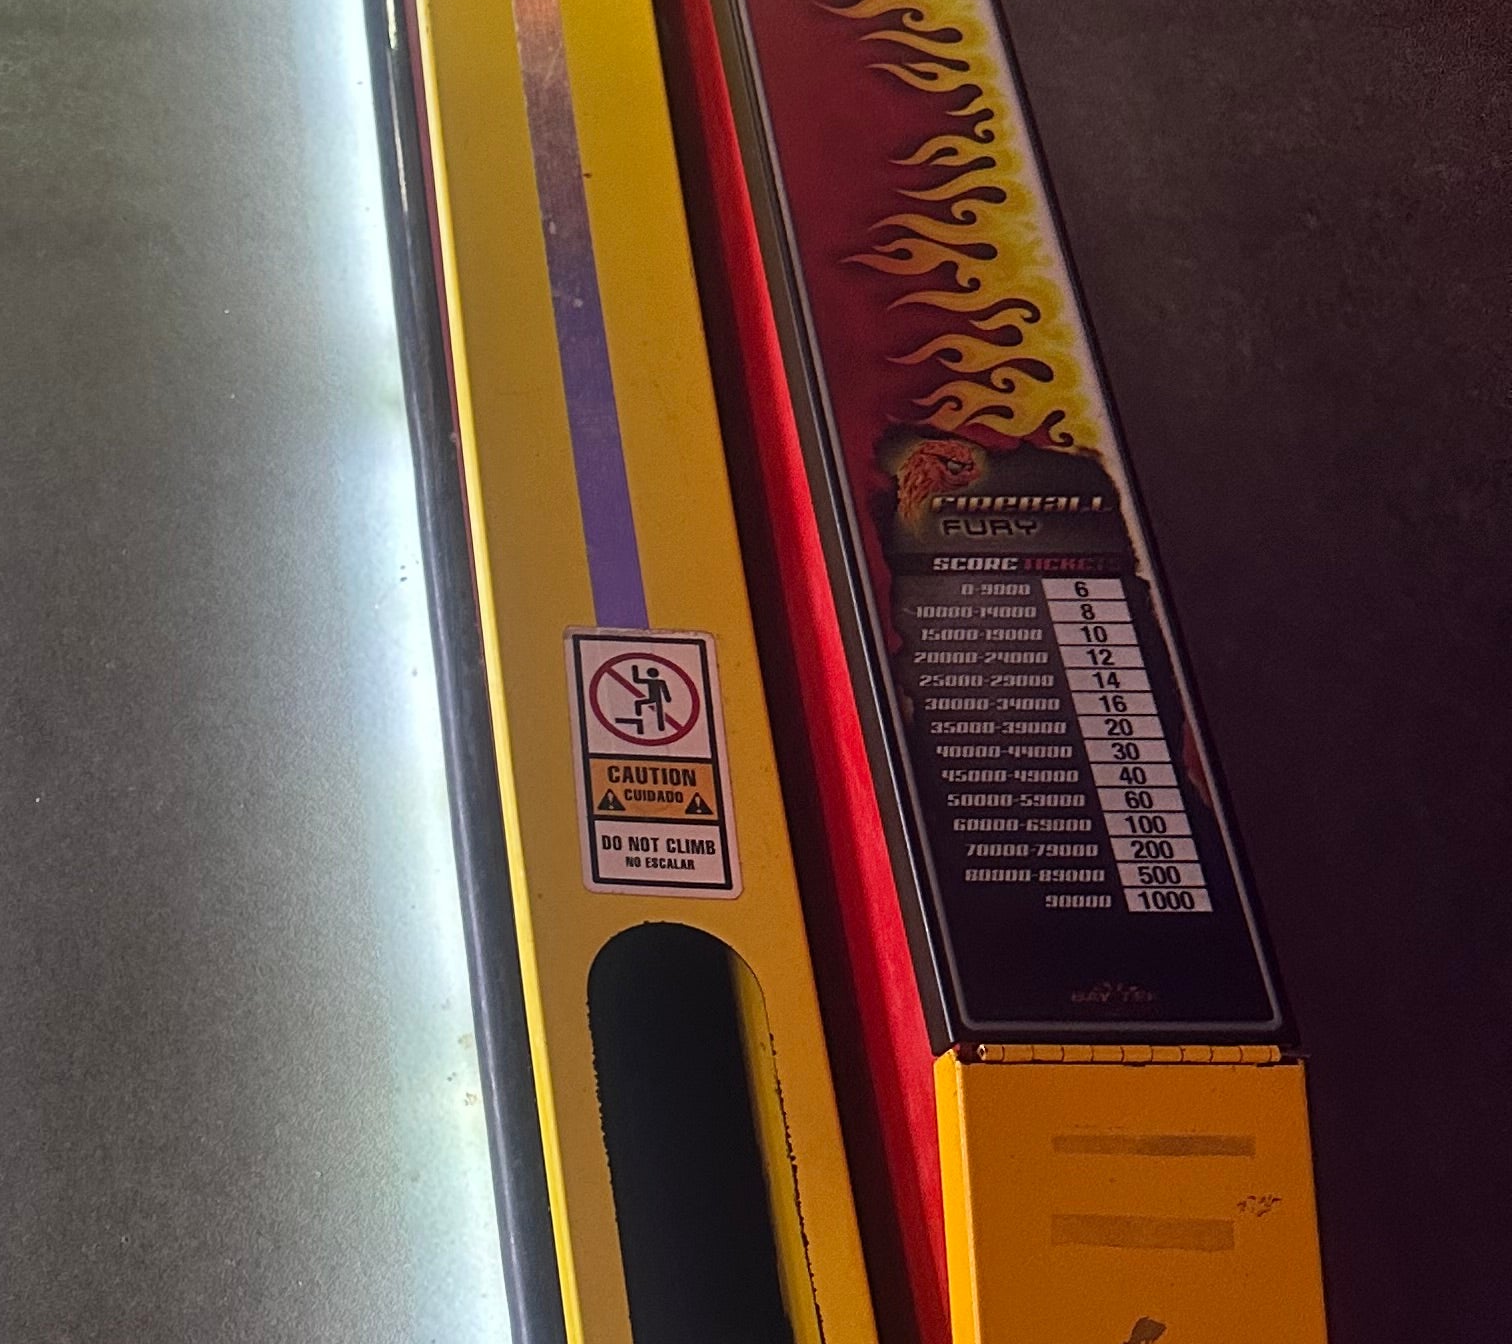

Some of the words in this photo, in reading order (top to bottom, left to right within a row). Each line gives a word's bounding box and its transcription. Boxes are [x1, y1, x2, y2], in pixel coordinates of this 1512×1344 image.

[941, 519, 1039, 536] FURY
[932, 557, 1020, 571] SCORE
[961, 583, 1031, 596] 0-9000
[1074, 581, 1089, 598] 6
[916, 606, 1037, 618] 10000-14000
[1080, 603, 1096, 620] 8
[921, 628, 1043, 641] 15000-19000
[1081, 625, 1108, 643] 10
[913, 651, 1049, 664] 20000-24000
[1086, 648, 1116, 666] 12
[919, 674, 1055, 687] 25000-29000
[1092, 671, 1121, 689] 14
[924, 697, 1061, 711] 30000-34000
[1098, 695, 1128, 713] 16
[930, 721, 1067, 734] 35000-39000
[1104, 718, 1134, 736] 20
[935, 745, 1073, 758] 40000-44000
[1111, 742, 1140, 761] 30
[607, 765, 697, 788] CAUTION
[941, 769, 1079, 783] 45000-49000
[1119, 766, 1148, 785] 40
[623, 788, 684, 804] CUIDADO
[946, 793, 1086, 807] 50000-59000
[1124, 790, 1154, 809] 60
[952, 818, 1092, 831] 60000-69000
[1125, 815, 1167, 834] 100
[601, 834, 622, 851] DO
[628, 836, 660, 853] NOT
[666, 837, 716, 856] CLIMB
[965, 843, 1099, 857] 70000-79000
[1130, 839, 1175, 859] 200
[625, 856, 642, 869] NO
[645, 856, 696, 871] ESCALAR
[964, 868, 1105, 882] 80000-89000
[1137, 865, 1182, 885] 500
[1045, 894, 1112, 908] 90000
[1137, 890, 1196, 910] 1000
